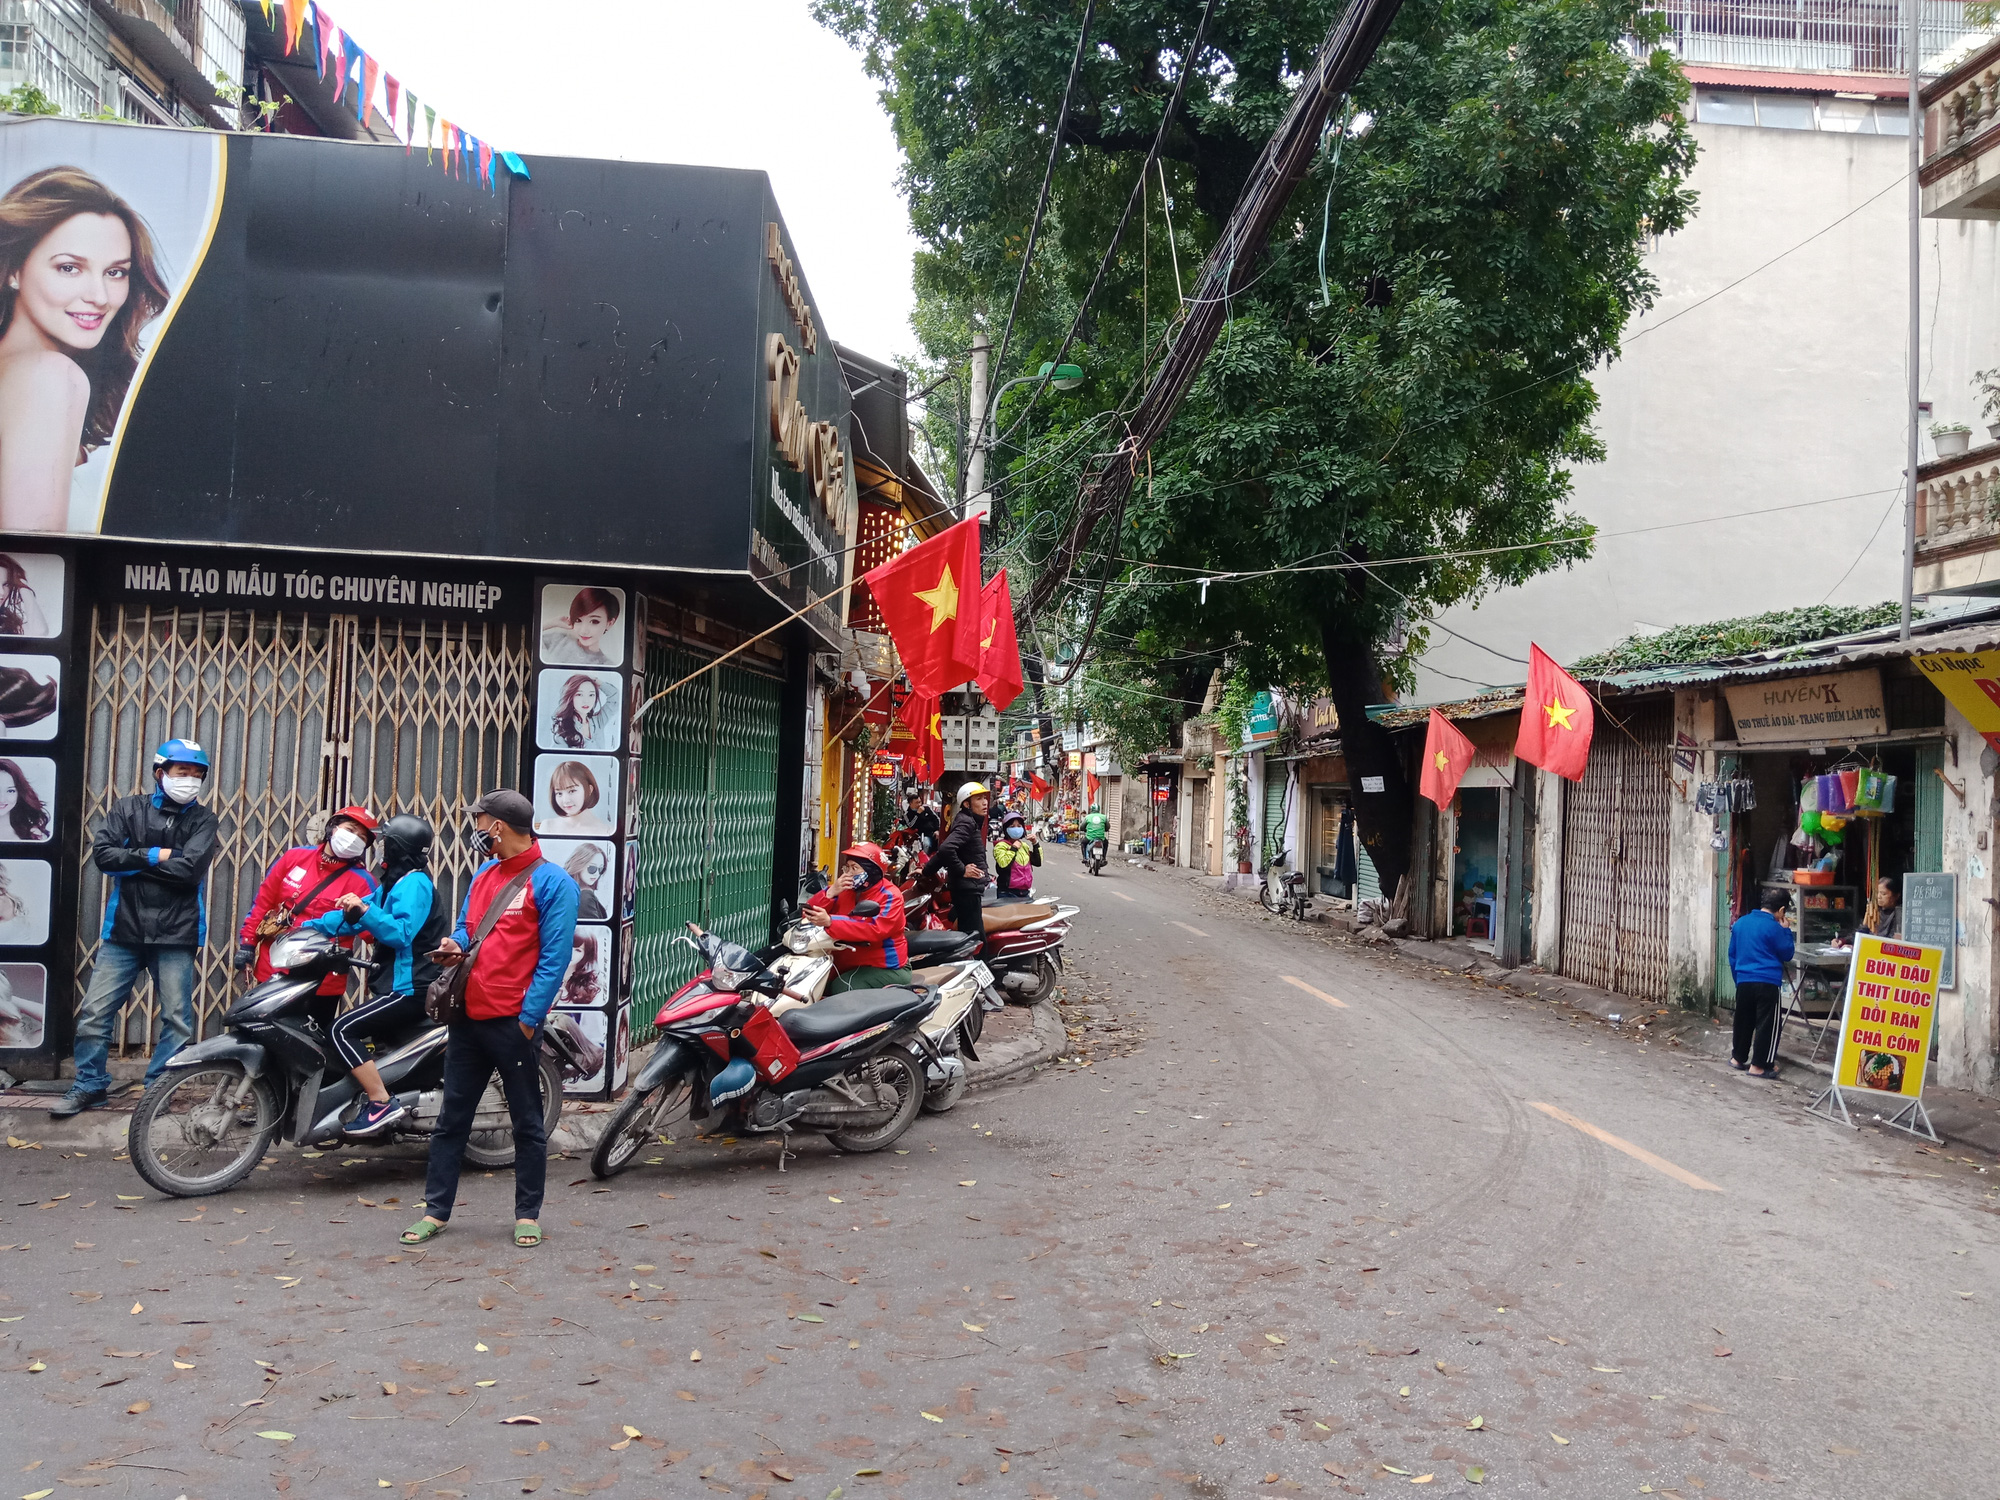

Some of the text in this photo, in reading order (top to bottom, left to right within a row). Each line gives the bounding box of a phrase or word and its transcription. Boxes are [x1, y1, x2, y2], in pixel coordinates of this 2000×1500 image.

[125, 561, 502, 613] NHÀ TẠO MẪU TÓC CHUYÊN NGHIỆP
[1737, 718, 1751, 730] CHO
[1752, 714, 1771, 728] THUÊ
[1782, 712, 1796, 726] DÀI
[1800, 712, 1825, 725] TRANG
[1865, 958, 1931, 984] BÚN ĐẬU
[1857, 981, 1931, 1008] THỊT LUỘC
[1860, 1003, 1920, 1030] DỒI RÁN
[1852, 1029, 1920, 1054] CHẢ CỐM
